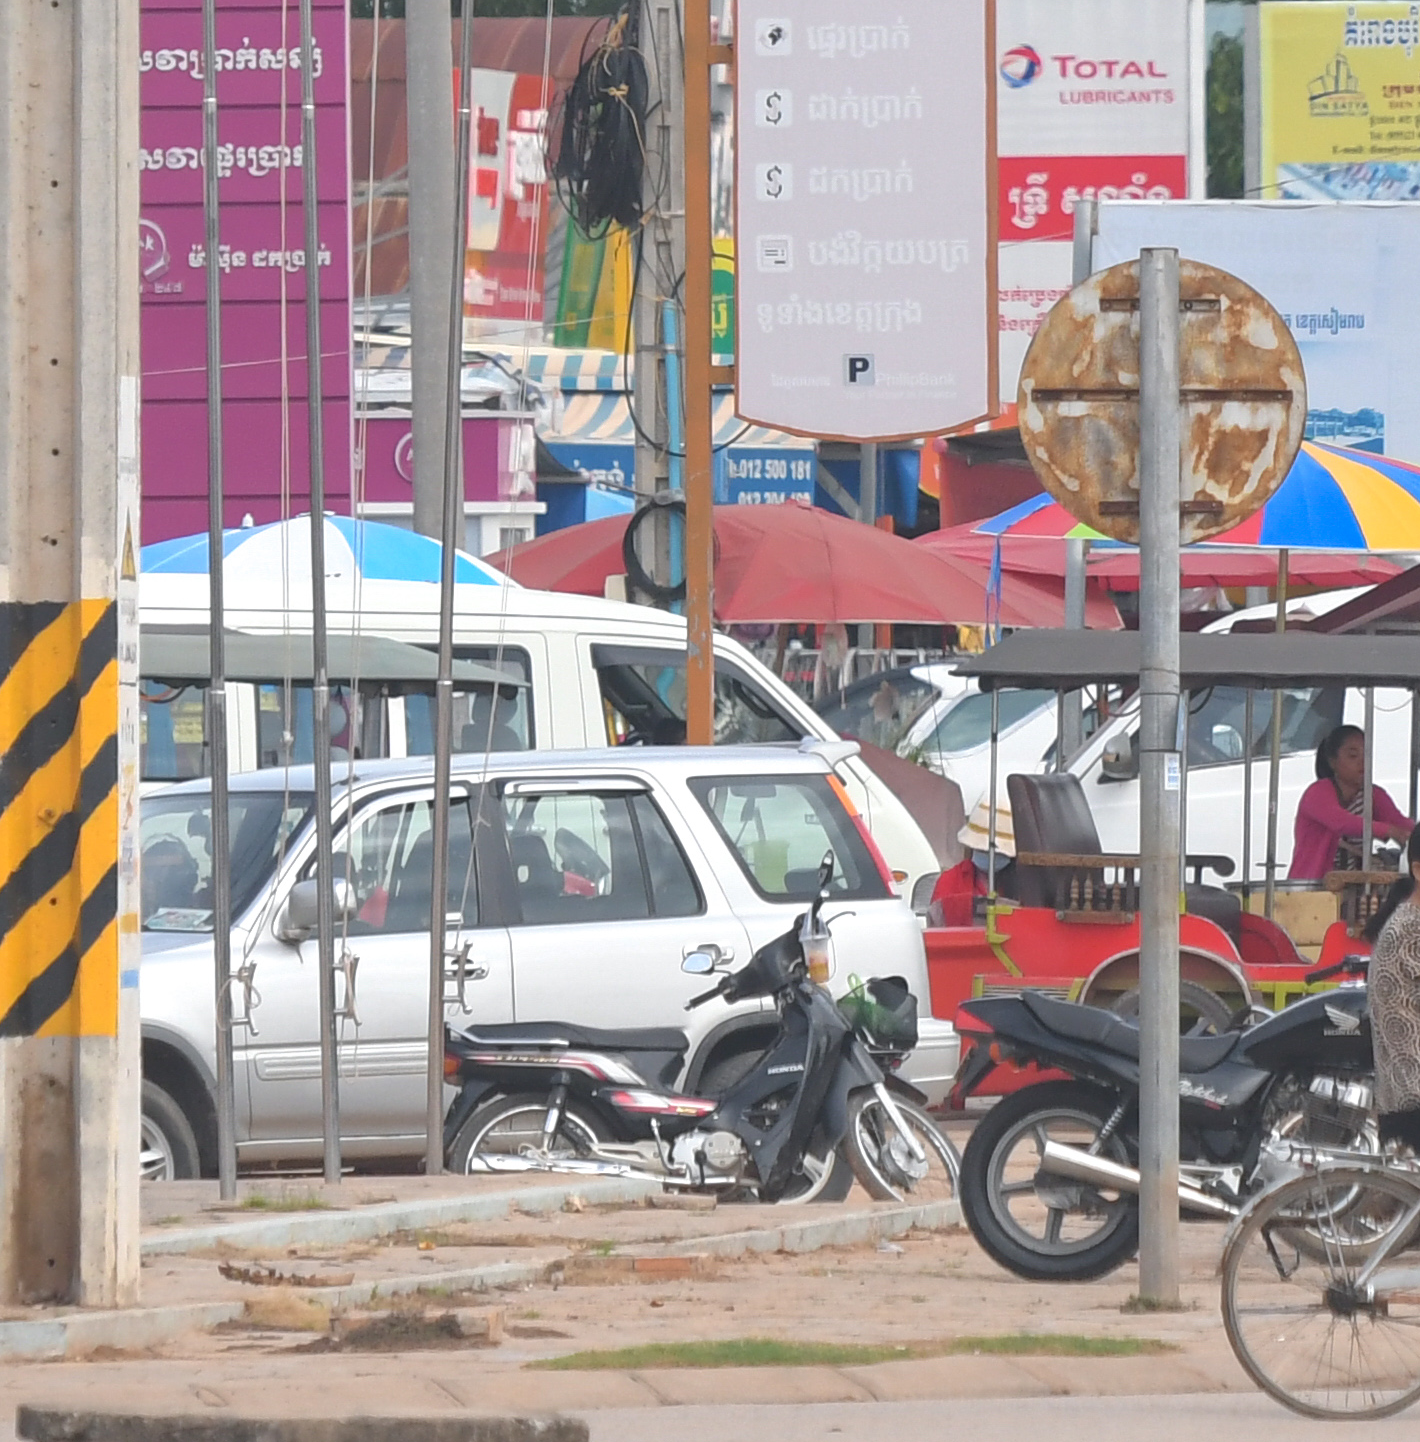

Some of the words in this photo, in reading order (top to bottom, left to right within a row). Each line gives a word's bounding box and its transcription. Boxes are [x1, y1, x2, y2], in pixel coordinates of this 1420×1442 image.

[1051, 55, 1168, 79] TOTAL
[1059, 89, 1174, 104] LUBRICANTS
[764, 459, 787, 479] 500
[1323, 1028, 1362, 1037] HONDA
[767, 1063, 804, 1075] HONDA
